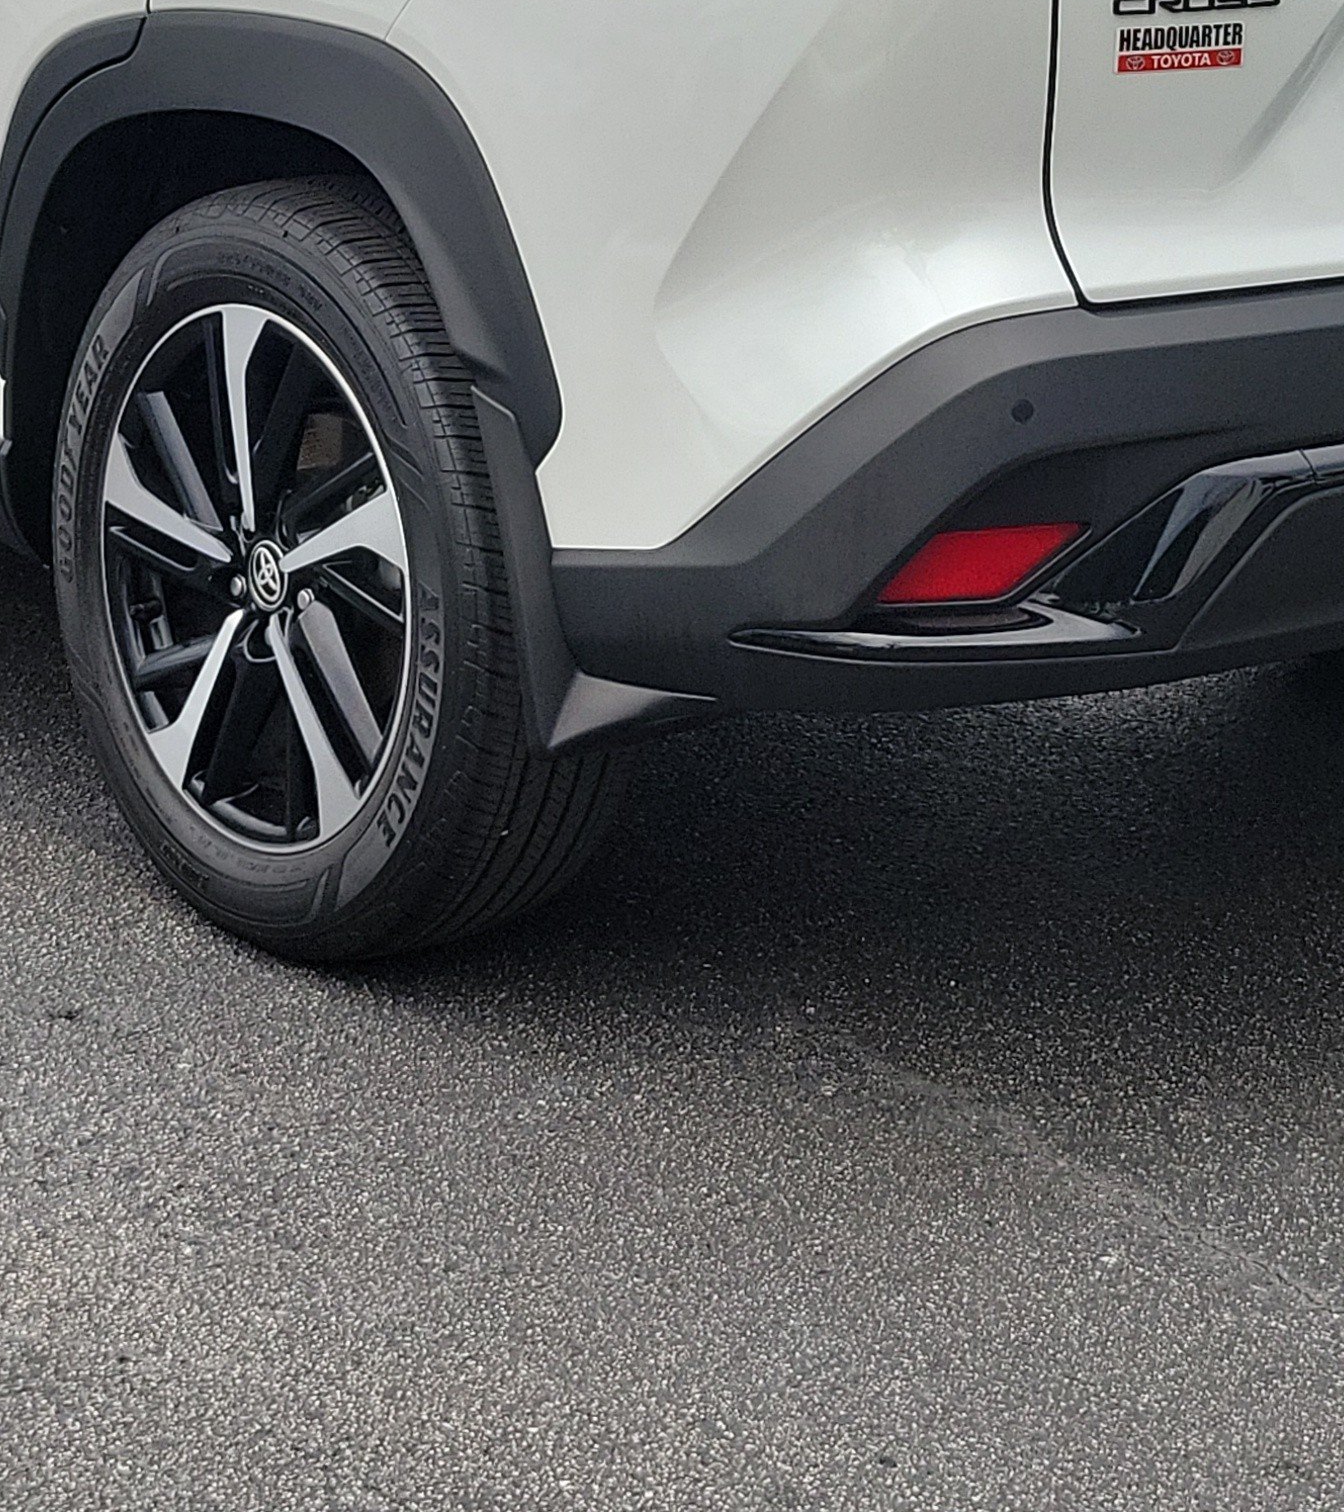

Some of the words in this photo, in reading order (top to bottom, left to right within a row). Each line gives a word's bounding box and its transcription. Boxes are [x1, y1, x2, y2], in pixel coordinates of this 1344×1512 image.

[1118, 23, 1244, 52] HEADQUARTER
[1151, 52, 1212, 69] TOYOTA
[376, 581, 442, 849] ASSURANCE
